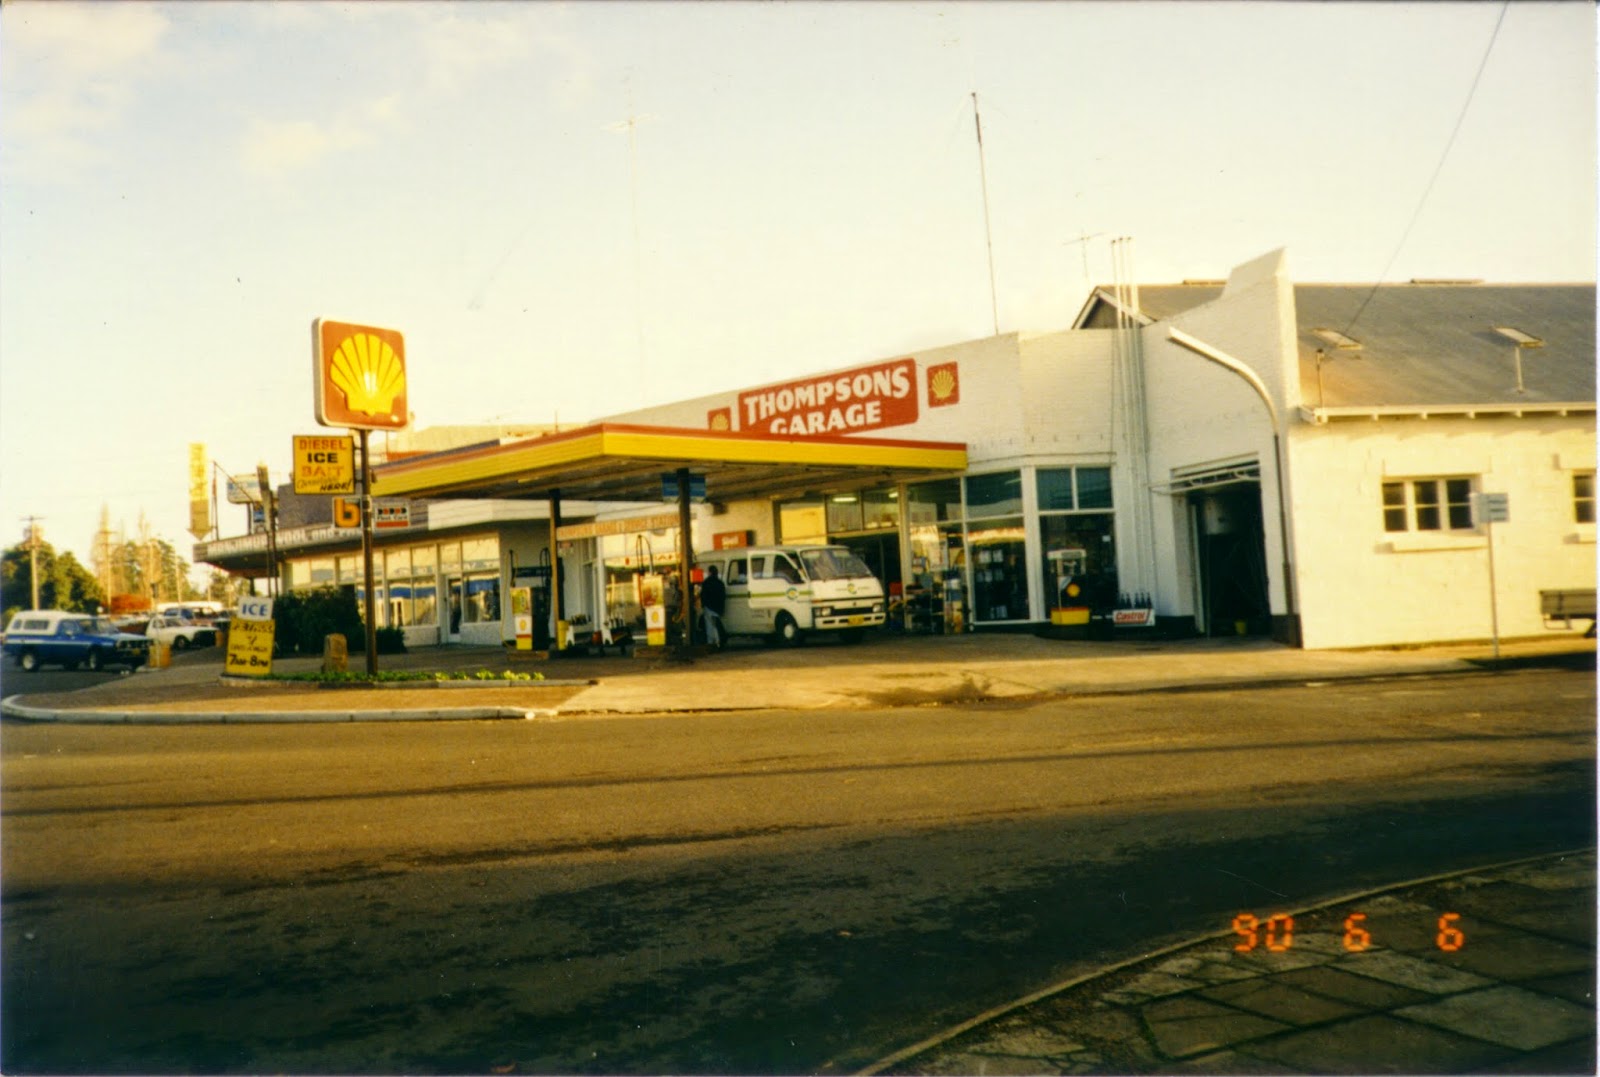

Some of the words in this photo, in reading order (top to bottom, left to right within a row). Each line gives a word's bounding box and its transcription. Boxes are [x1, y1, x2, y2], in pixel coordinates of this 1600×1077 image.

[743, 366, 910, 426] THOMPSONS
[770, 400, 882, 436] GARAGE
[299, 439, 347, 450] DIESEL
[307, 453, 338, 463] ICE
[301, 466, 344, 477] BAIT
[242, 603, 268, 616] ICE
[1115, 611, 1147, 623] Castrol
